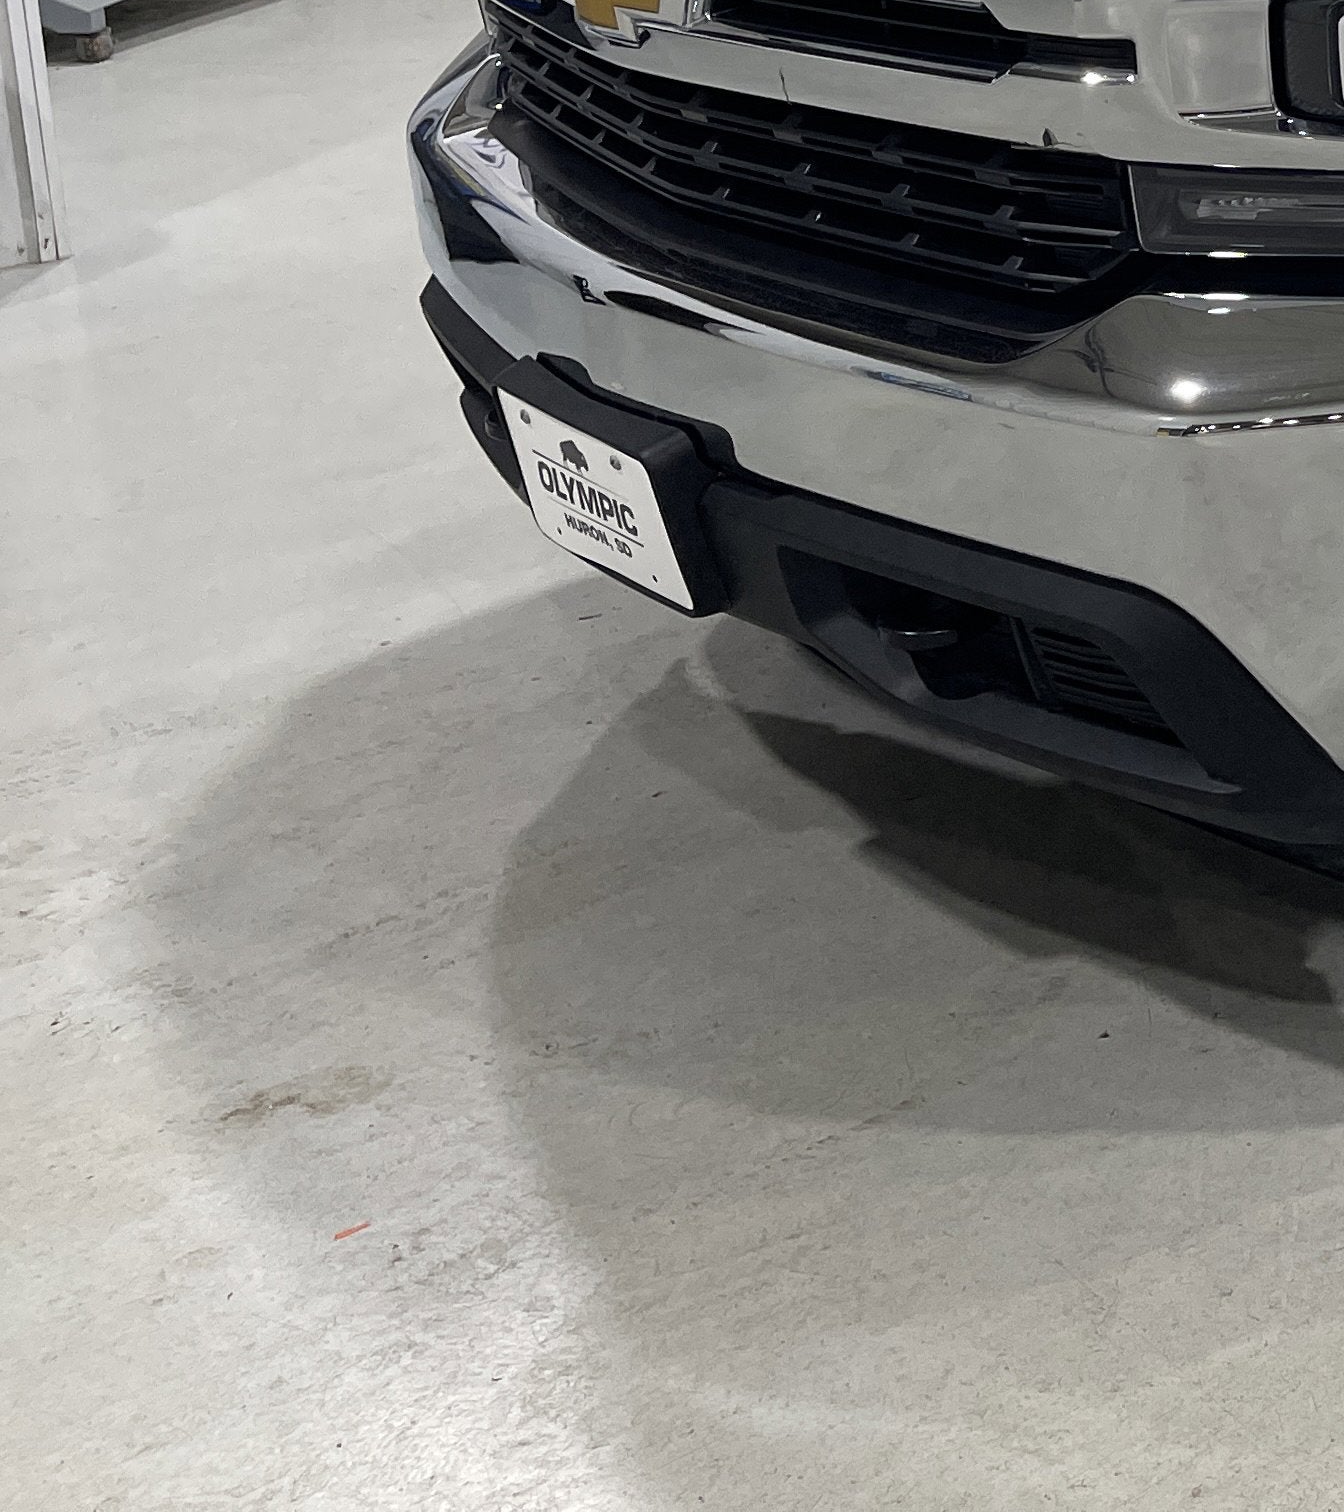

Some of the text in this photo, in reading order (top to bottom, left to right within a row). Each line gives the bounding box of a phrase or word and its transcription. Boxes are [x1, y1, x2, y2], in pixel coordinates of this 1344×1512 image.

[537, 460, 639, 537] OLYMPIC
[564, 512, 633, 558] HURON, SD
